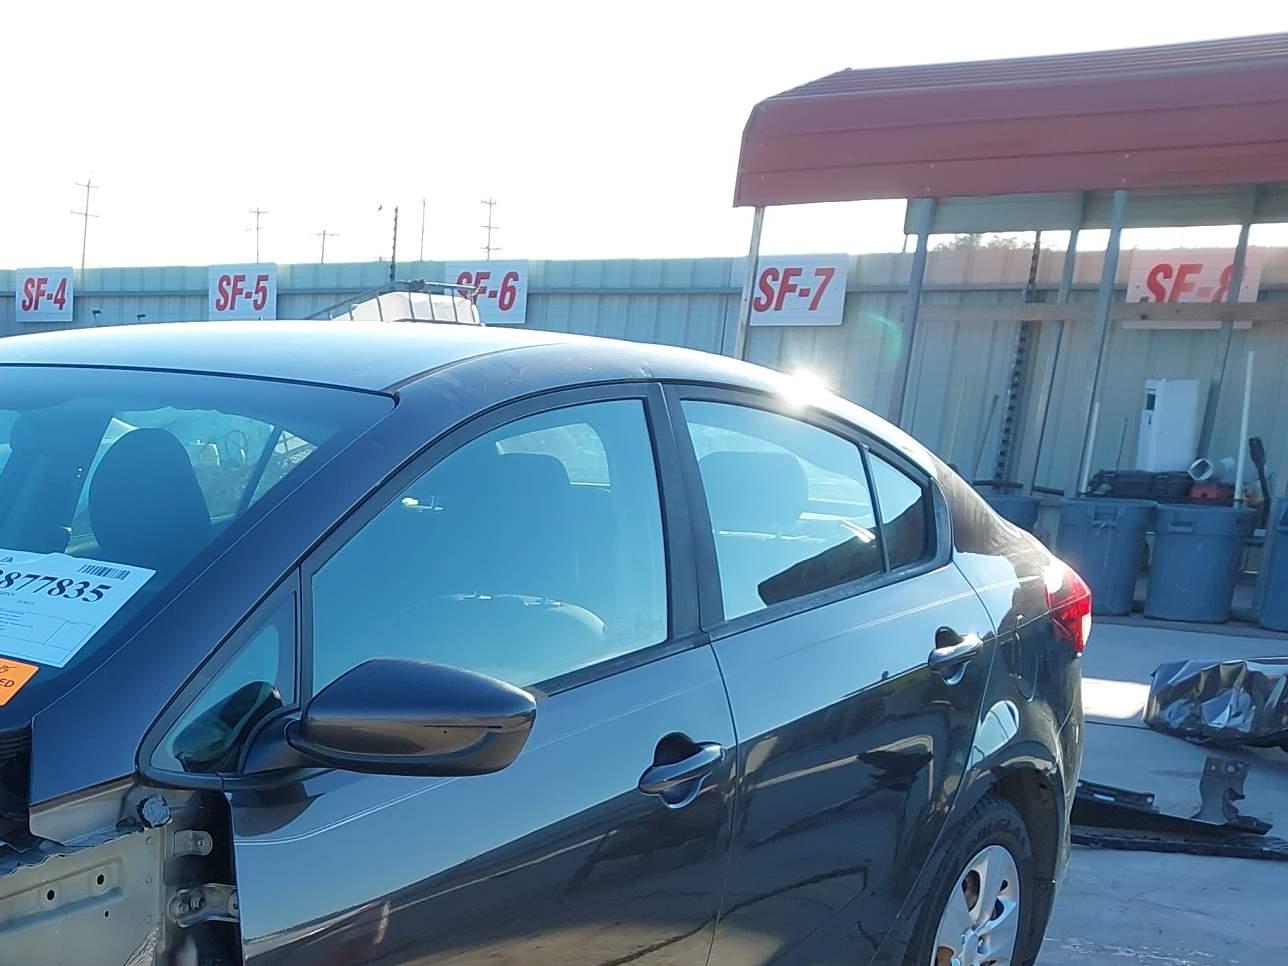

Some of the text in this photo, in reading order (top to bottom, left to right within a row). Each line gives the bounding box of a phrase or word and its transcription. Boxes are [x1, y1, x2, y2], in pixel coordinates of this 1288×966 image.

[21, 277, 67, 311] SF-4
[215, 274, 269, 311] SF-5
[456, 271, 519, 311] SF-6
[753, 266, 835, 312] SF-7
